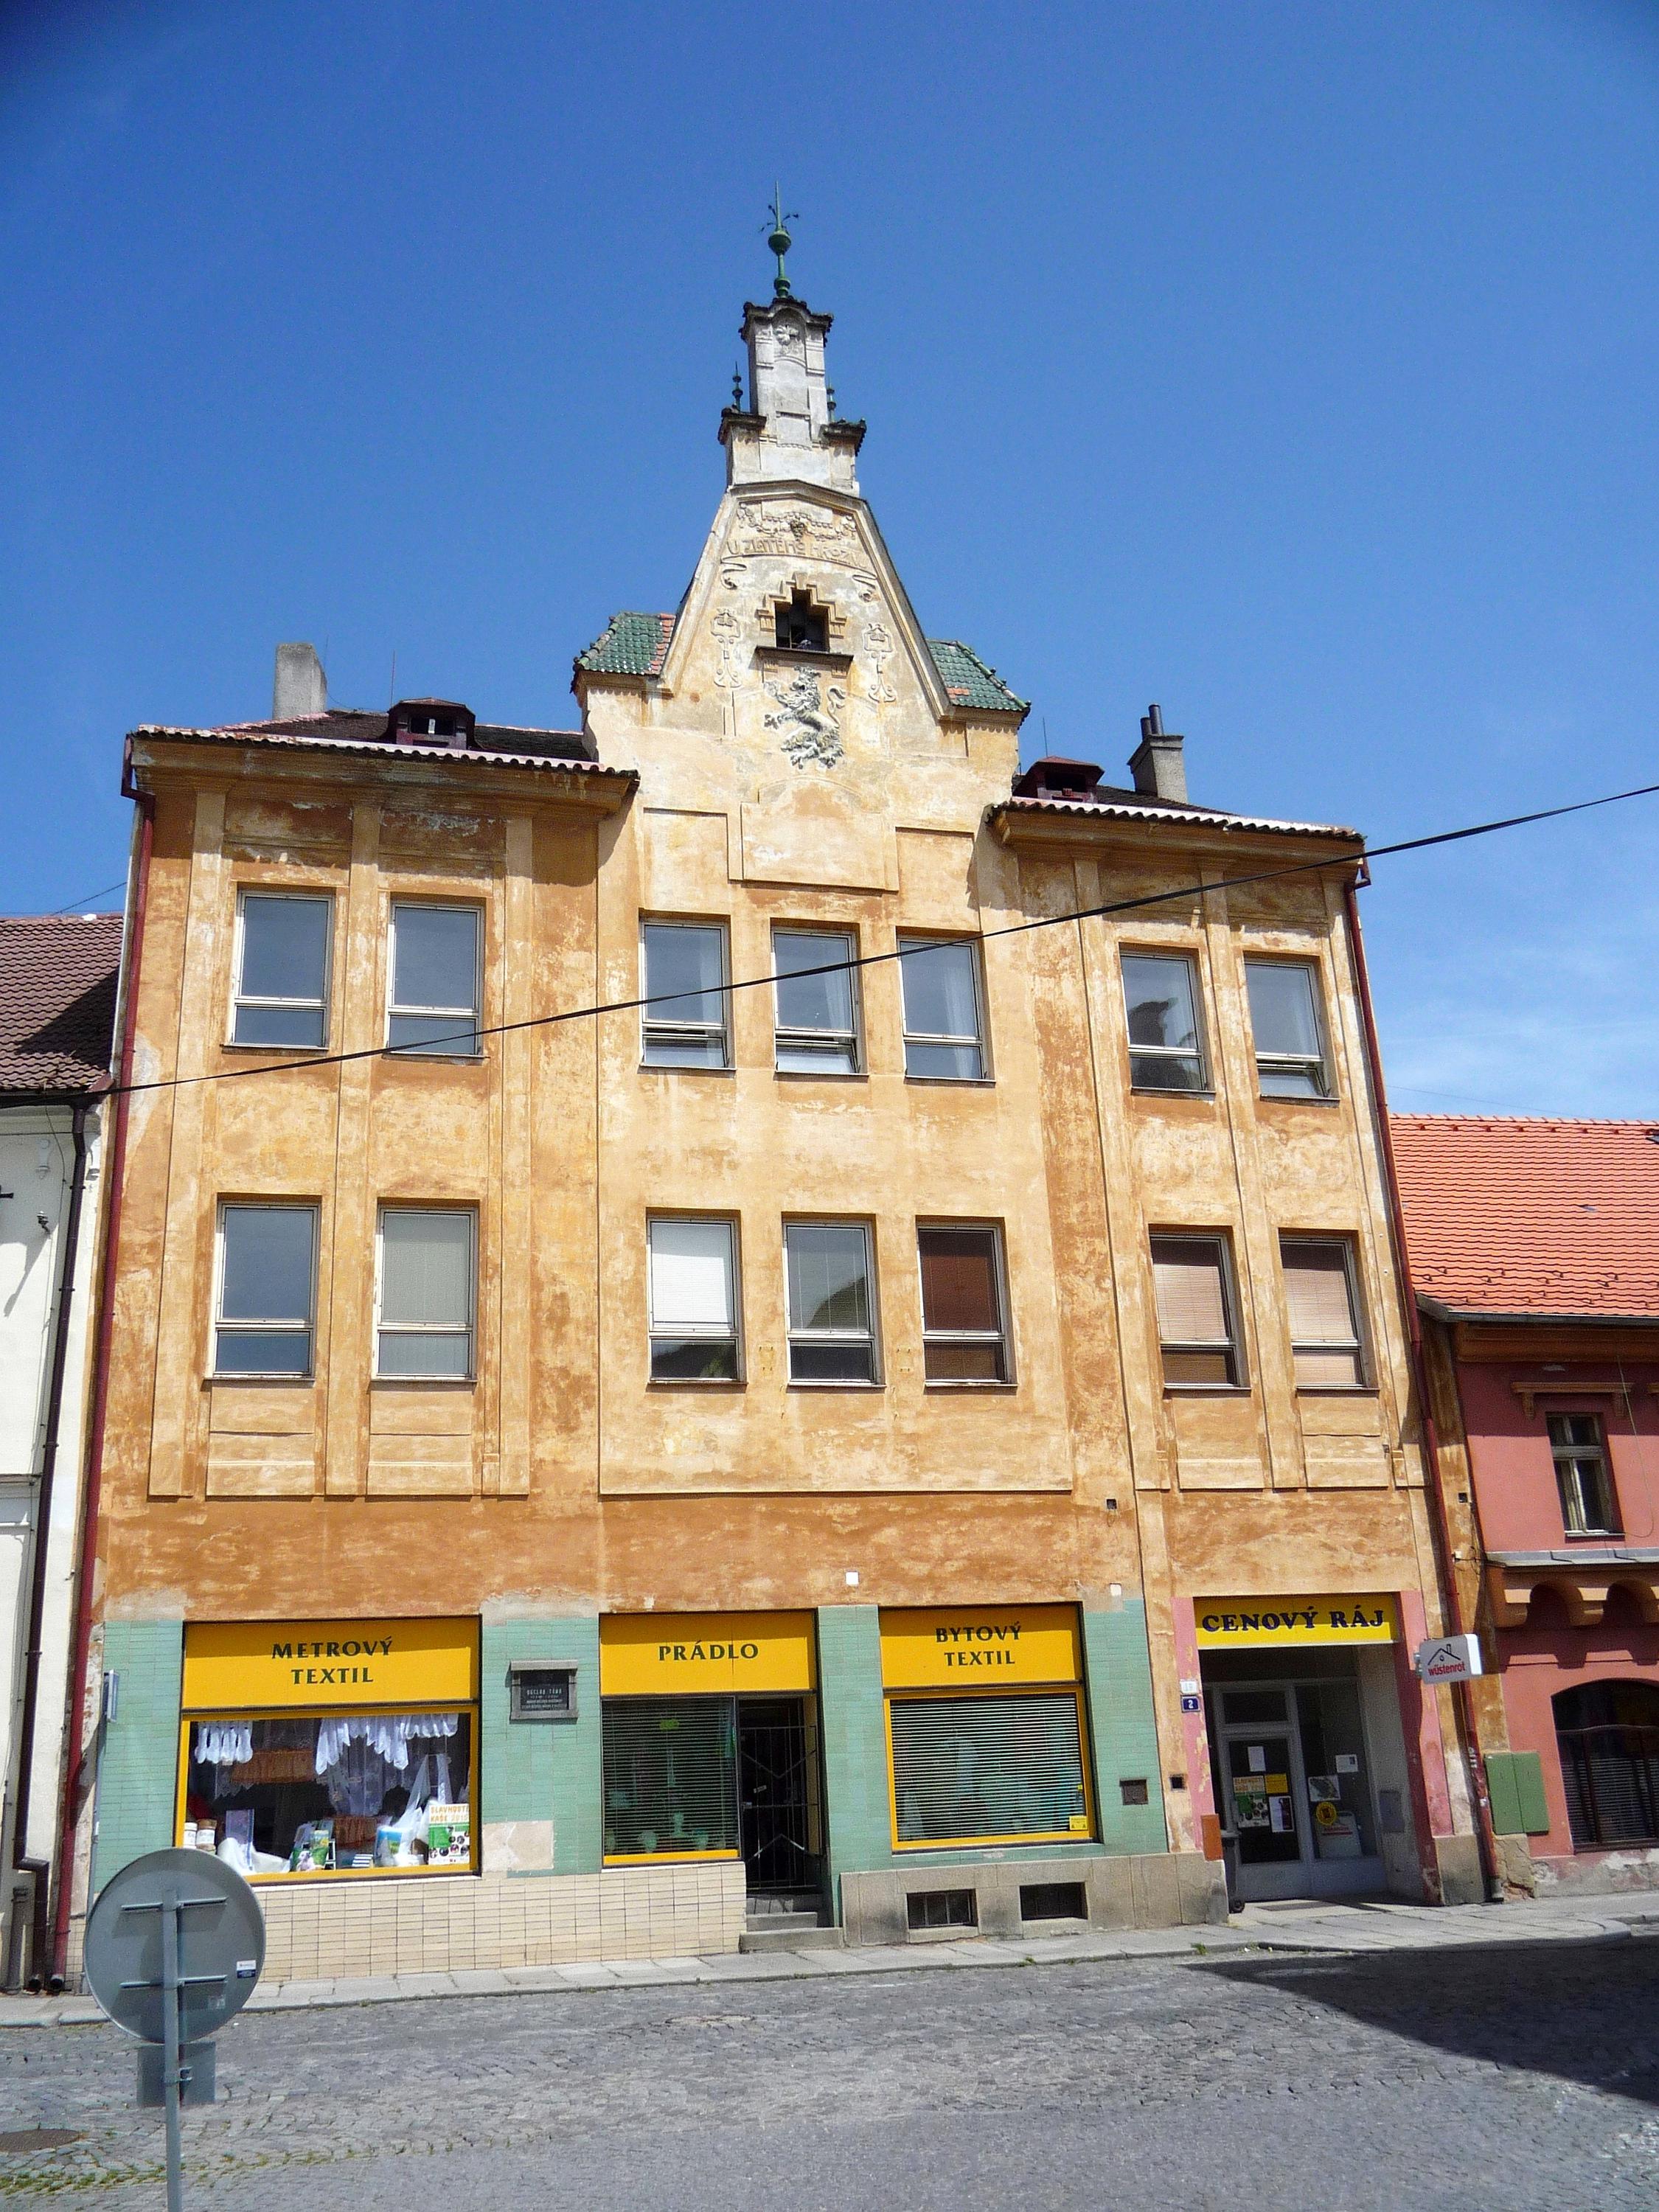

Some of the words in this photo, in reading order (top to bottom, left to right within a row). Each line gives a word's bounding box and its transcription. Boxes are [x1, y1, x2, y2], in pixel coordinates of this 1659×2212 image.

[727, 540, 740, 555] U
[1202, 1606, 1318, 1632] CENOVÝ
[1329, 1604, 1384, 1628] RÁJ
[935, 1621, 1021, 1643] BYTOVÝ
[271, 1635, 393, 1659] METROVÝ
[658, 1640, 759, 1661] PRÁDLO
[944, 1650, 1015, 1666] TEXTIL
[291, 1667, 374, 1685] TEXTIL
[1427, 1661, 1466, 1676] wüstenrot
[1188, 1700, 1194, 1708] 2
